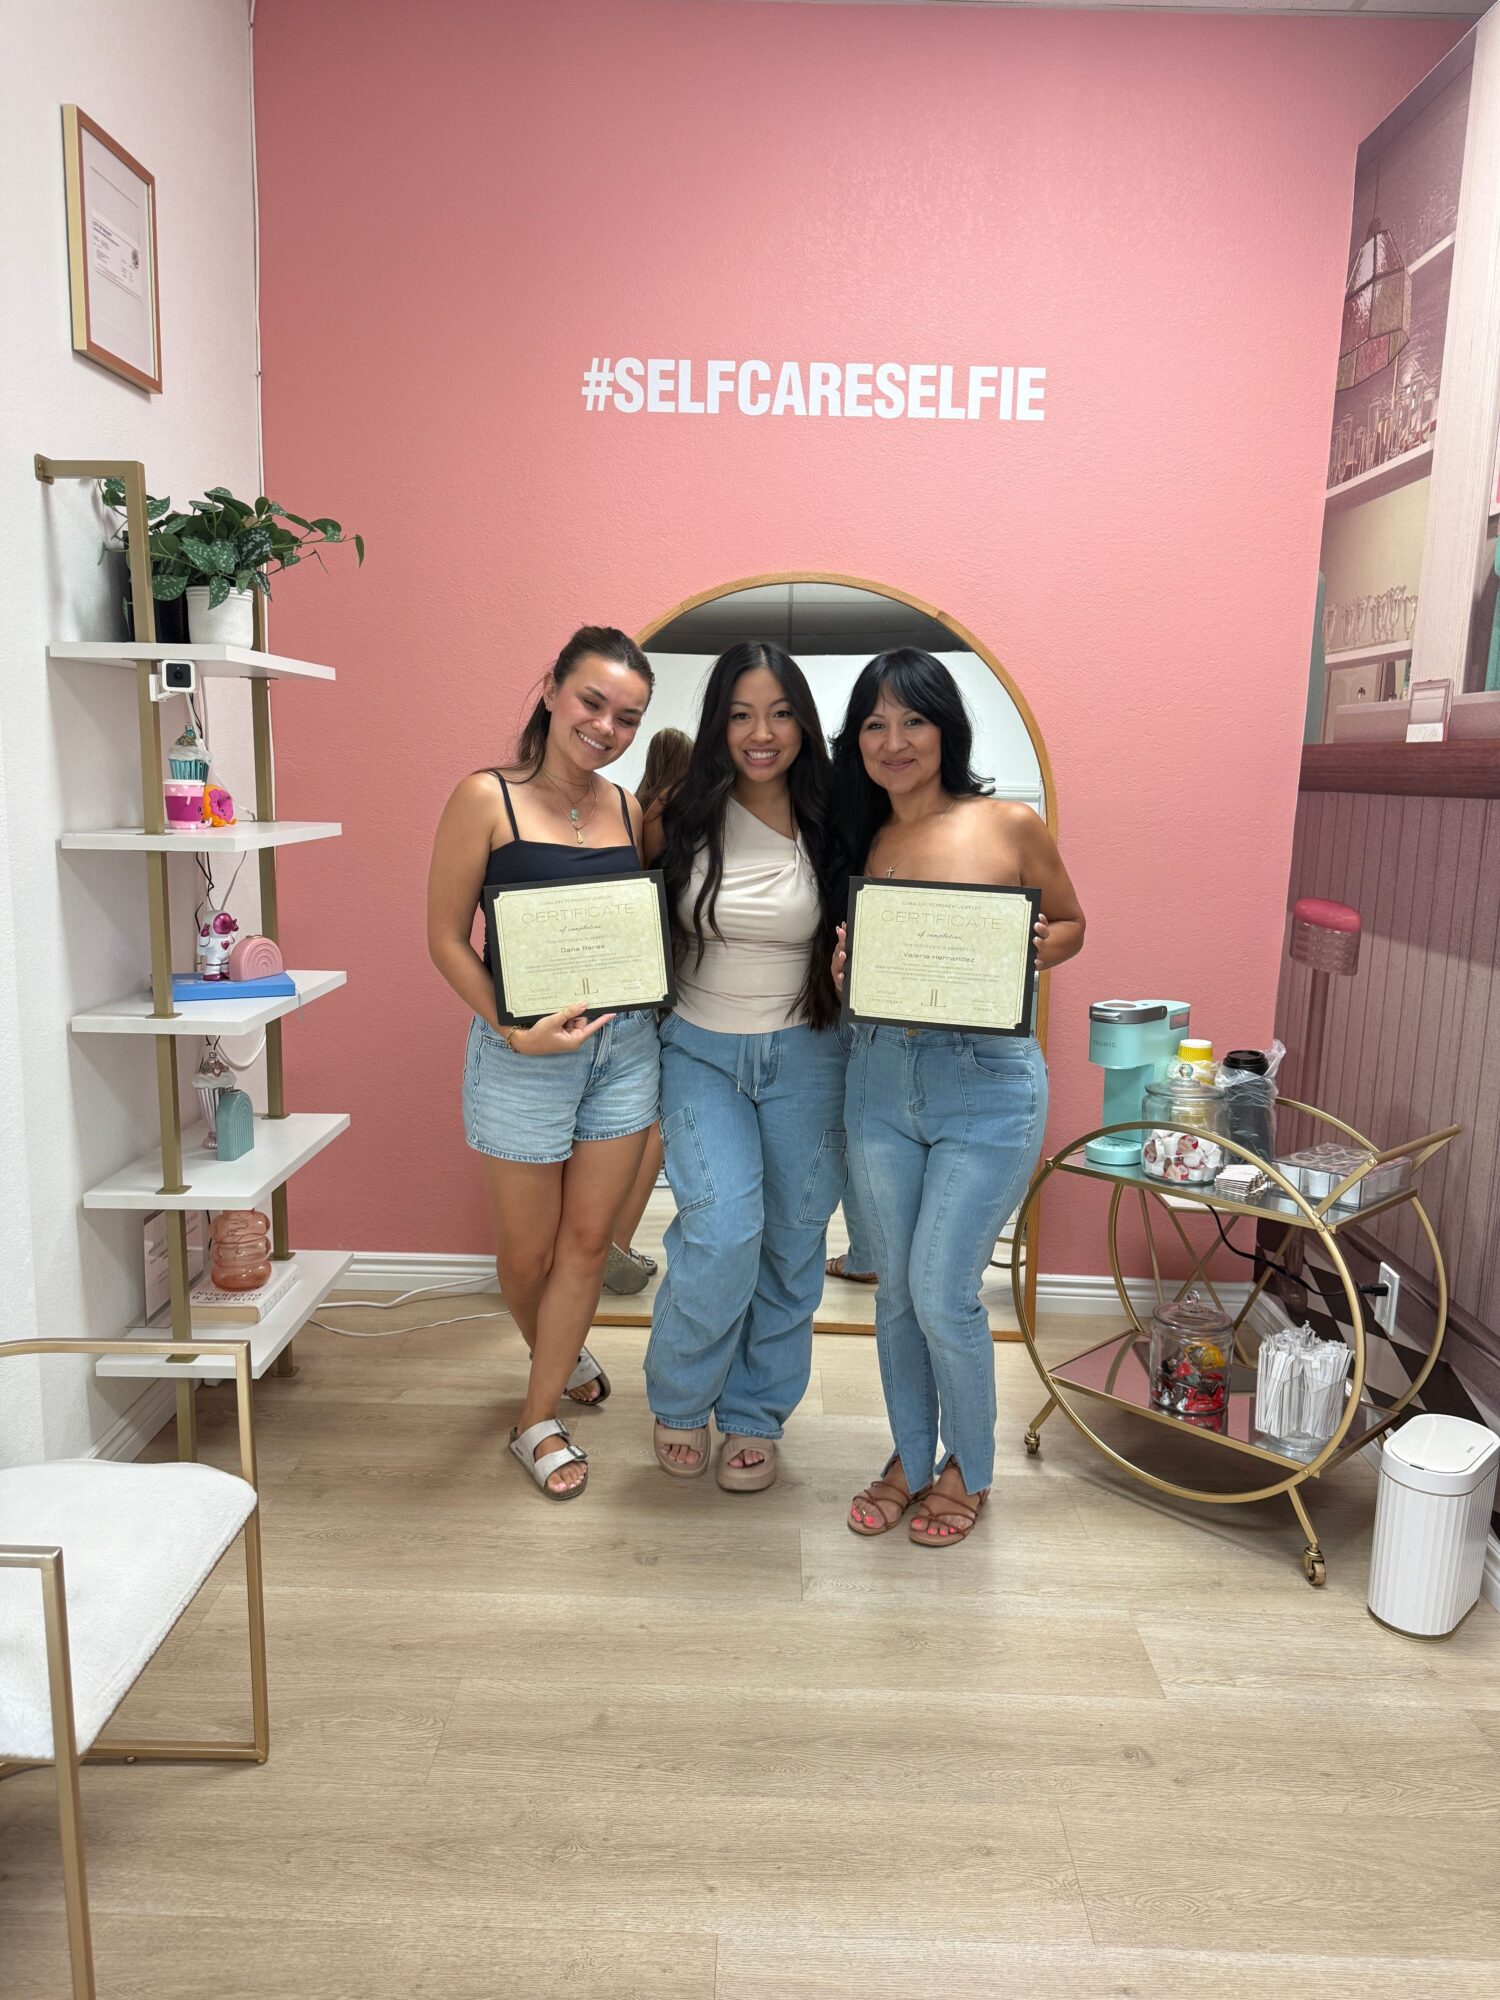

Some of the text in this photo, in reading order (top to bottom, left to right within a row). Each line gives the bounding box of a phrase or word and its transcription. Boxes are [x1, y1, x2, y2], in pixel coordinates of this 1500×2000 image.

[581, 356, 1047, 421] #SELFCARESELFIE
[521, 903, 636, 925] CERTIFICATE
[881, 910, 1004, 930] CERTIFICATE
